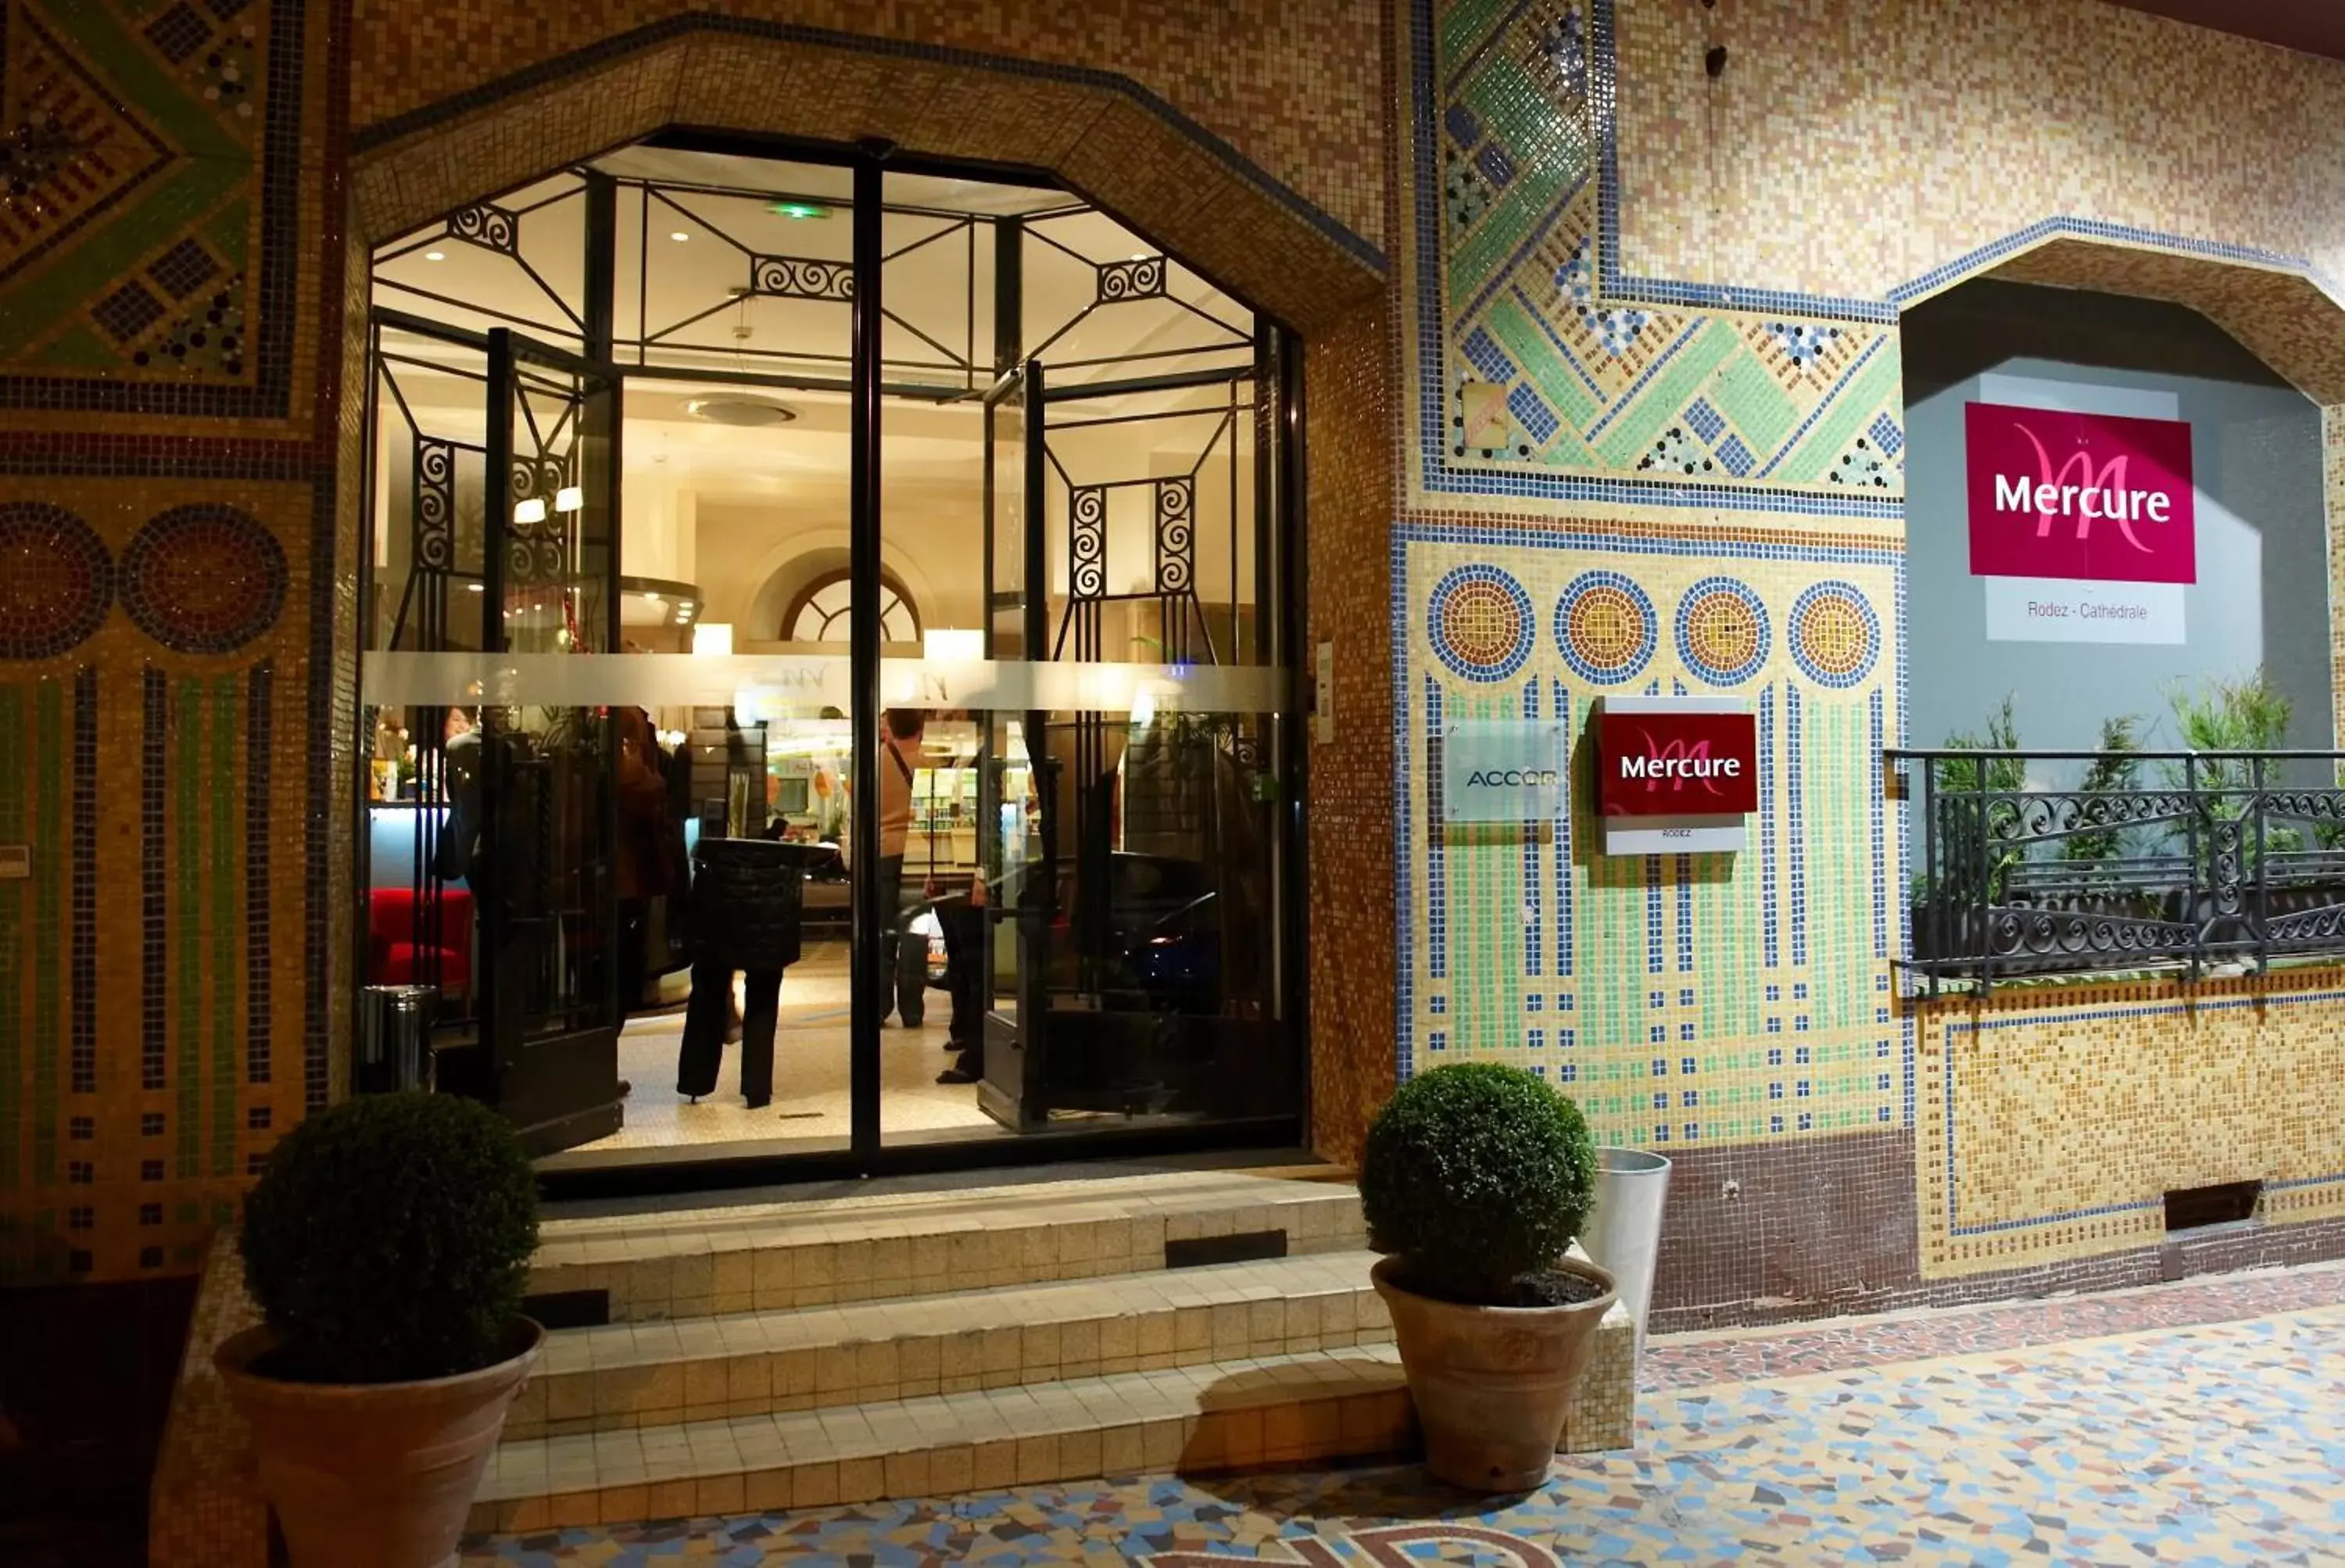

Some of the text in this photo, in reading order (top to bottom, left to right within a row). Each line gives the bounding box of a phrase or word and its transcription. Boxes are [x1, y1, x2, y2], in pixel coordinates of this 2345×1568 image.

[1995, 474, 2171, 523] Mercure
[2028, 601, 2069, 618] Rodez
[2080, 603, 2147, 620] Cathédrale
[1620, 755, 1741, 779] Mercure
[1466, 770, 1557, 787] ACCOR
